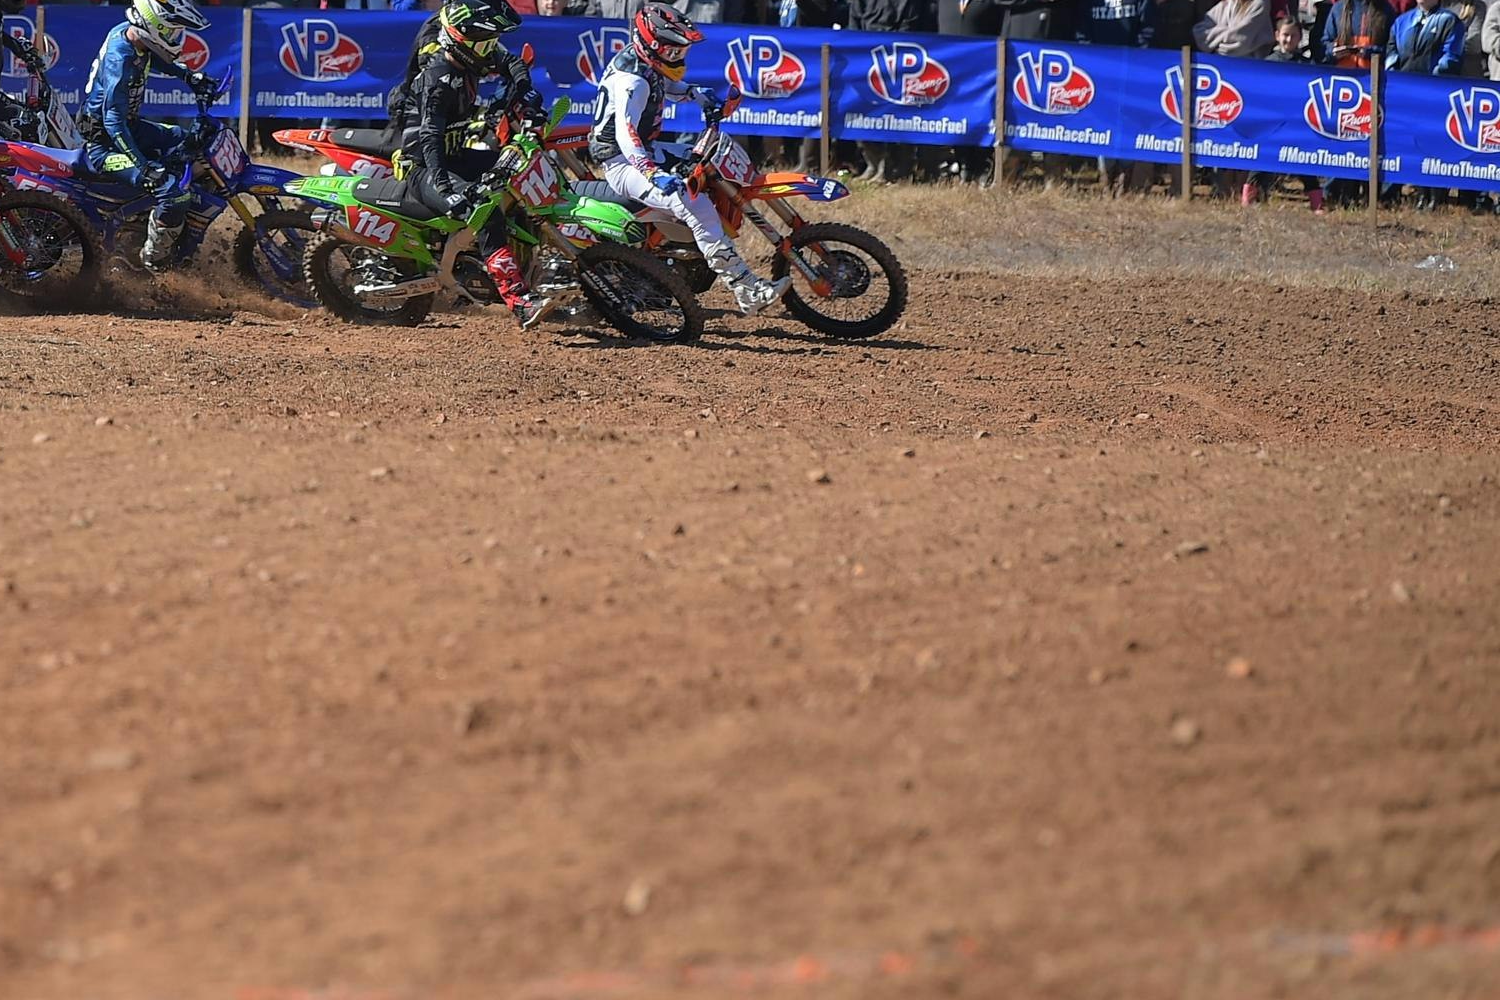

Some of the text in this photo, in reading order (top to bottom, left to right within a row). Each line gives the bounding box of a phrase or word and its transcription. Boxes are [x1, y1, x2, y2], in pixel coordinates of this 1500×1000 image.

[281, 19, 340, 77] VP
[726, 34, 784, 97] VP
[870, 42, 929, 103] VP
[256, 91, 384, 110] #MoreThanRaceFuel
[1017, 49, 1075, 113] VP
[1307, 75, 1364, 137] VP
[844, 111, 968, 136] #MoreThanRaceFuel
[519, 154, 559, 207] 114
[354, 210, 397, 244] 114
